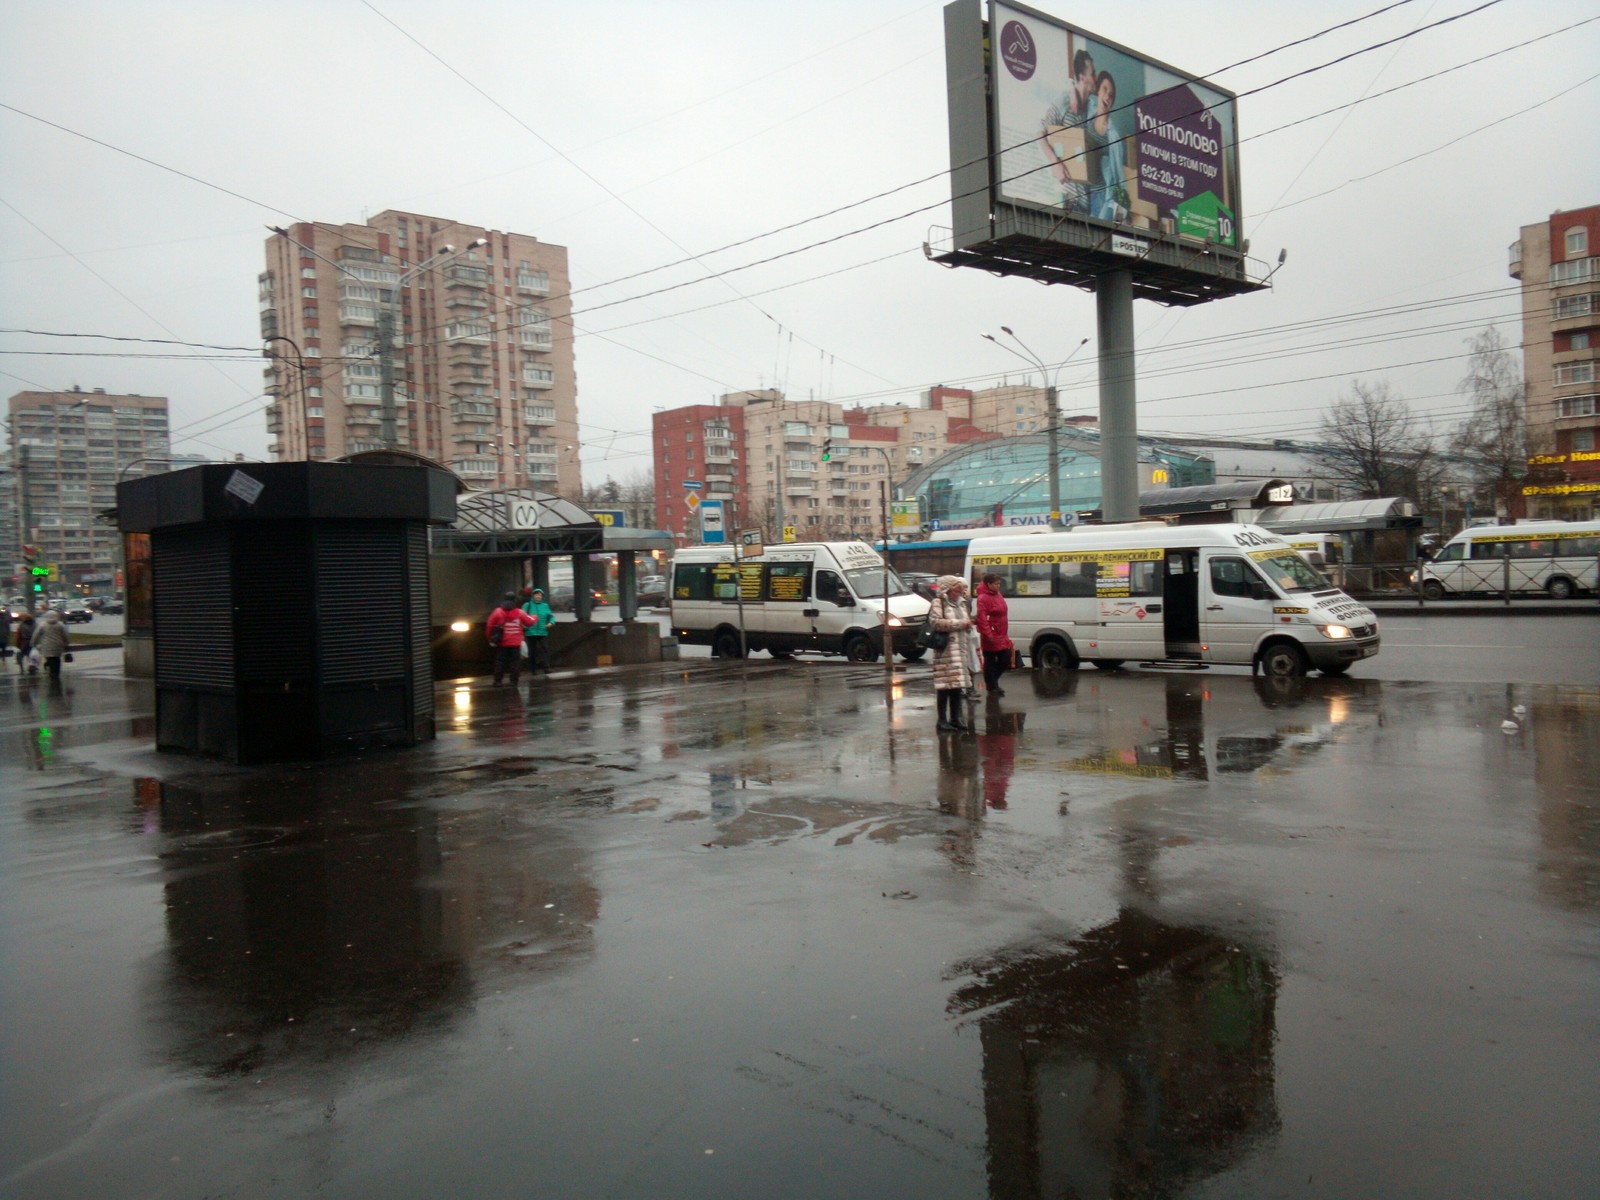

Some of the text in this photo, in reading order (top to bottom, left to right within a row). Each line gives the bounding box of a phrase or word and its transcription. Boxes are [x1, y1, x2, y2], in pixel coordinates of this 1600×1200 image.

[1141, 141, 1218, 179] КЛЮЧИ В ЭТОМ ГОДУ
[1141, 163, 1186, 189] 602-20-20
[1218, 217, 1232, 238] 10
[1233, 531, 1268, 548] 420
[973, 557, 1002, 565] МЕТРО
[1007, 554, 1055, 564] ПЕТЕРГОФ
